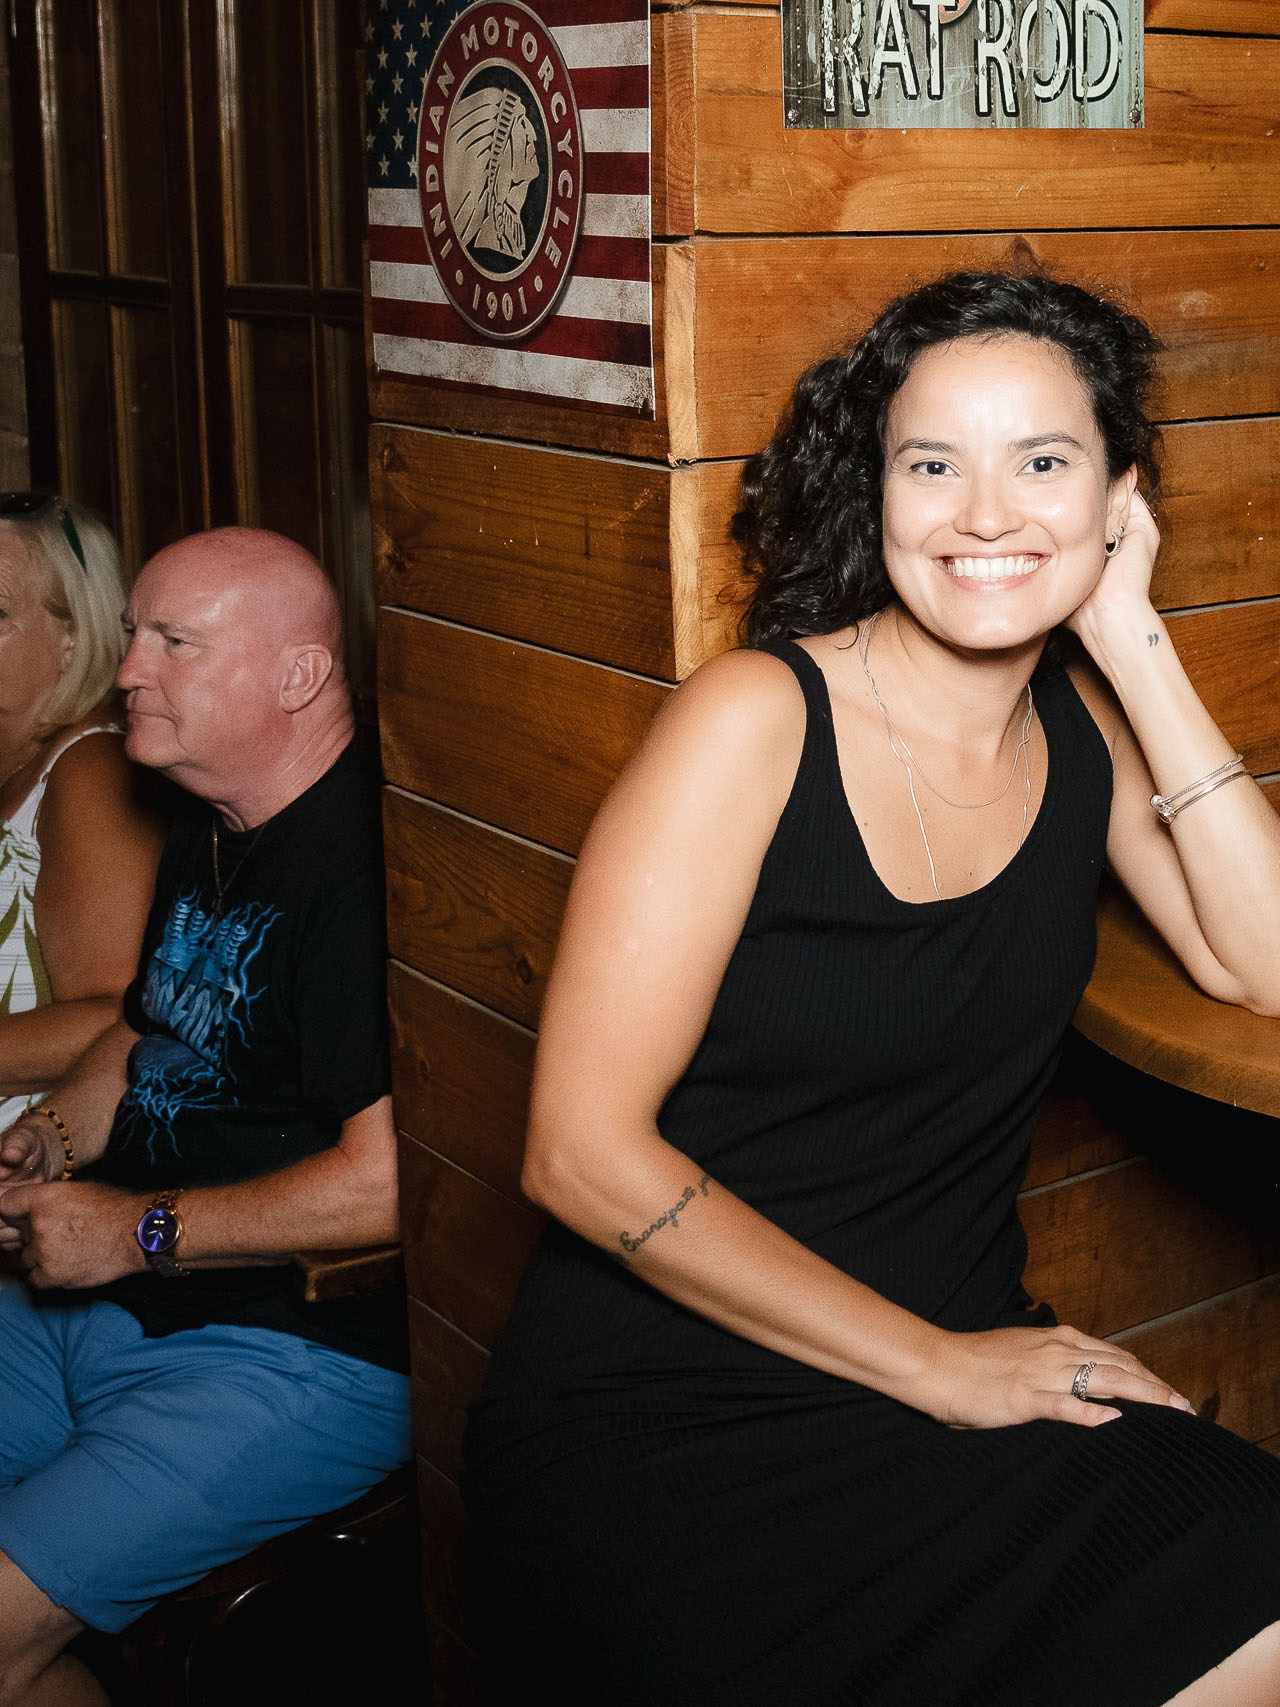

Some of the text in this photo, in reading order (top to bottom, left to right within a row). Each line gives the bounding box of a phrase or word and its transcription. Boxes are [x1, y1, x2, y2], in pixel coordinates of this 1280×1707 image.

[820, 0, 1124, 116] RAT ROD
[425, 16, 574, 270] INDIAN MOTORCYCLE
[472, 286, 528, 322] 1901
